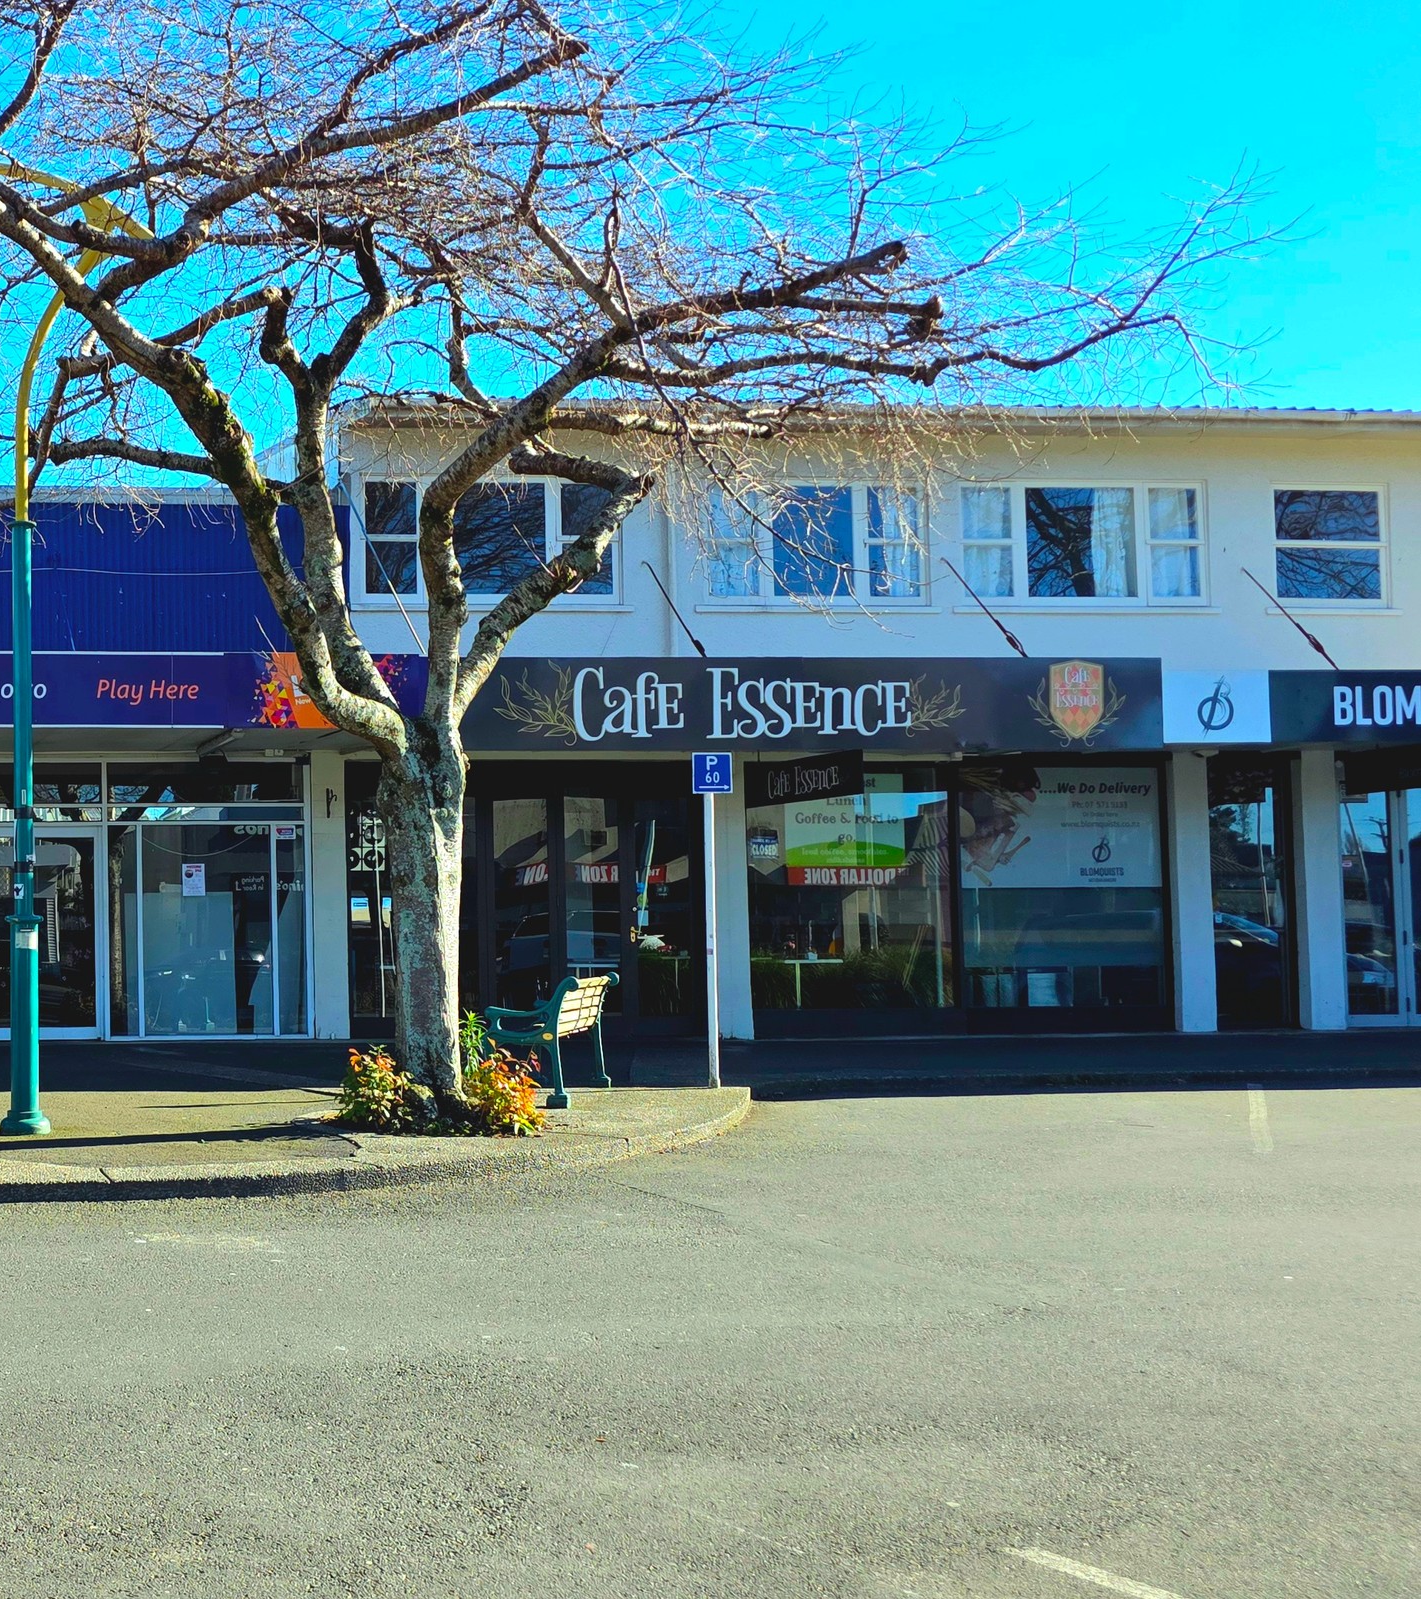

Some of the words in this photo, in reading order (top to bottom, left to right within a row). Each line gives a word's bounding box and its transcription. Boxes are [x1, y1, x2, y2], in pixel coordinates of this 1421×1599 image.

[97, 678, 144, 705] Play
[149, 680, 199, 699] Here
[1333, 685, 1421, 726] BLOM
[706, 756, 718, 770] P
[705, 771, 720, 783] 60
[1081, 783, 1095, 794] Do
[1098, 782, 1151, 796] Delivery
[840, 812, 851, 824] &
